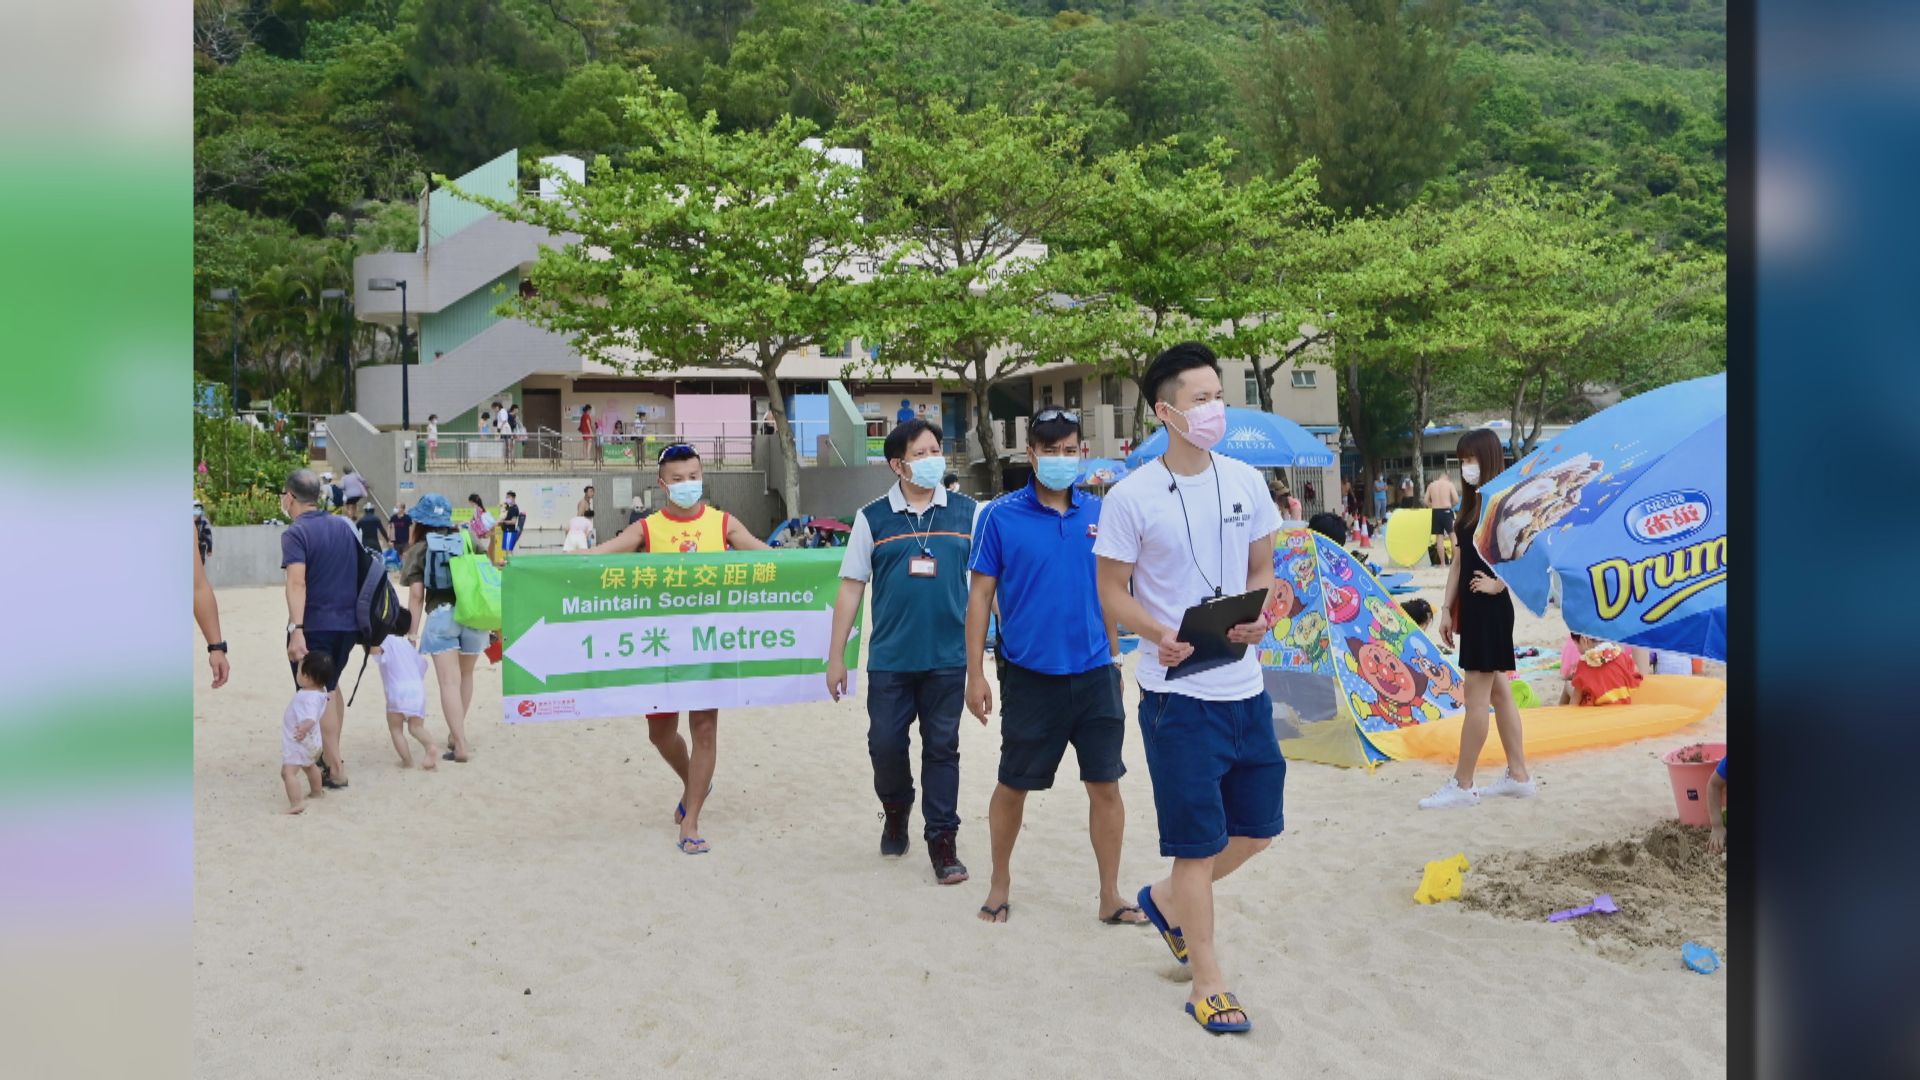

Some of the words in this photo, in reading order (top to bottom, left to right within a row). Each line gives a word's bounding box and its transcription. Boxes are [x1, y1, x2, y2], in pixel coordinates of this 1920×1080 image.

[600, 562, 777, 589] 保持社交距離
[562, 593, 651, 615] Maintain
[658, 591, 721, 608] Social
[728, 588, 814, 605] Distance
[692, 625, 797, 652] Metres
